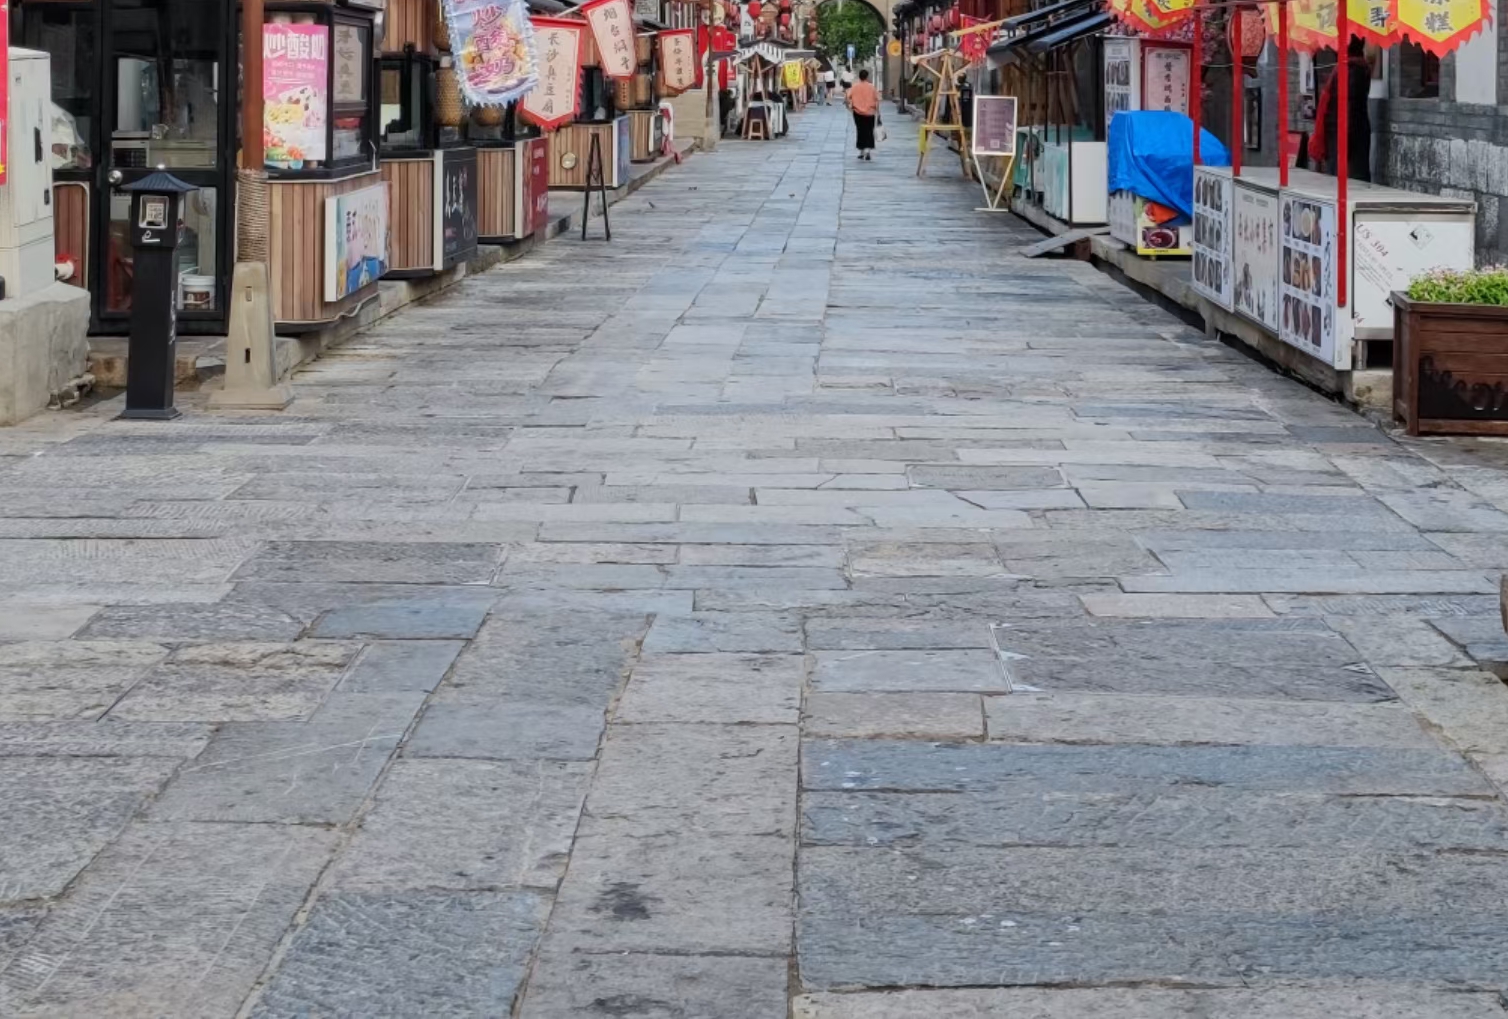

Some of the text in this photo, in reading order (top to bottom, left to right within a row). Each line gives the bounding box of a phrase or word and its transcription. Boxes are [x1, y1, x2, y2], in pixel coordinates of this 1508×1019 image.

[543, 32, 563, 114] 长沙臭豆腐
